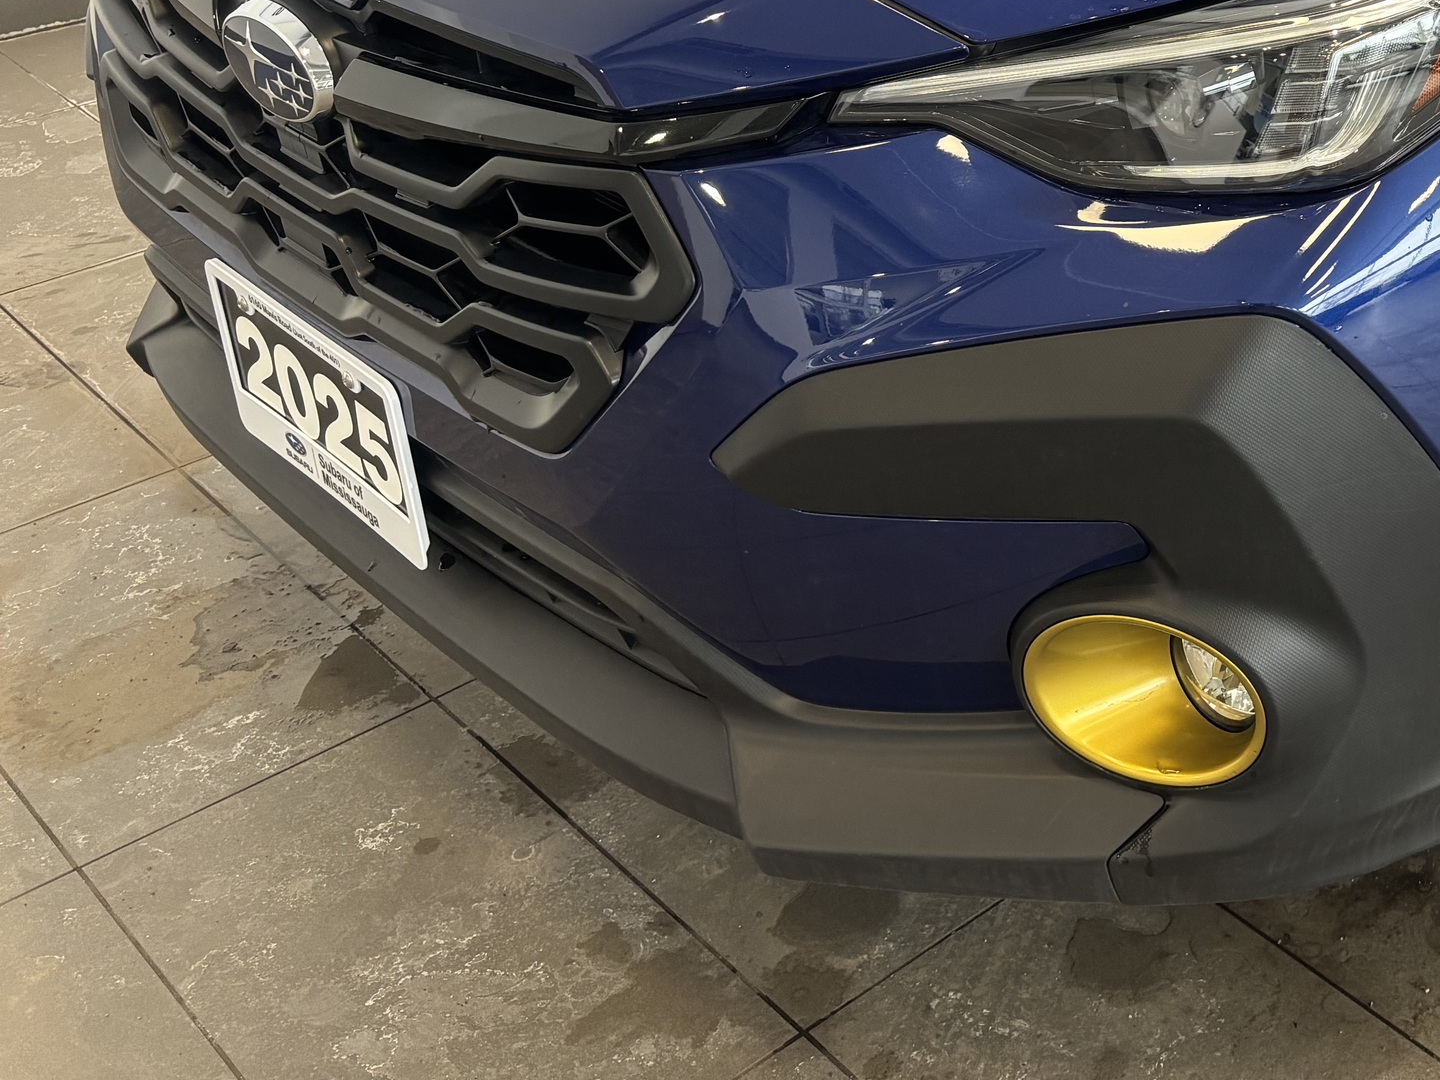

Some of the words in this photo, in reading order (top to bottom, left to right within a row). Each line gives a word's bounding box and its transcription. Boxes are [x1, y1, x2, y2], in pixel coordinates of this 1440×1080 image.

[235, 315, 403, 506] 2025
[286, 448, 314, 474] SUBARU
[318, 453, 352, 491] Subaru
[353, 485, 364, 500] of
[321, 470, 380, 529] Mississauga
